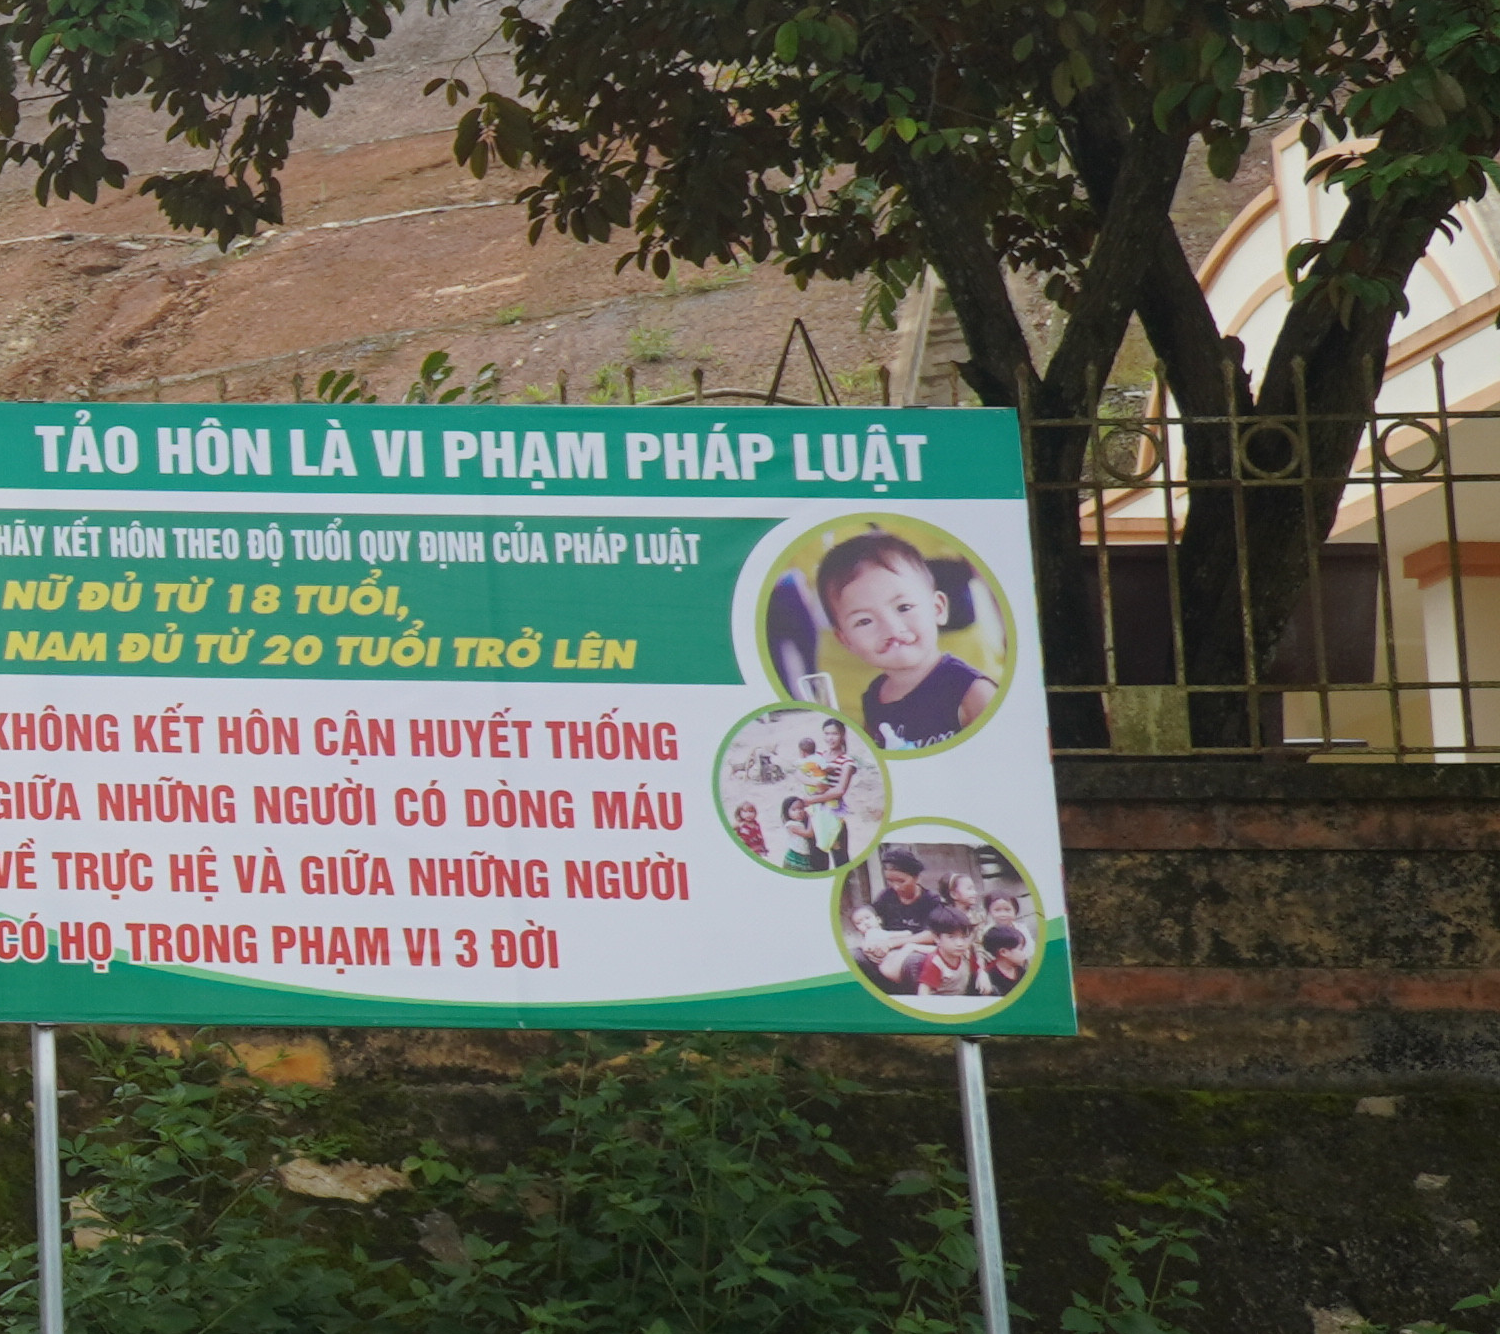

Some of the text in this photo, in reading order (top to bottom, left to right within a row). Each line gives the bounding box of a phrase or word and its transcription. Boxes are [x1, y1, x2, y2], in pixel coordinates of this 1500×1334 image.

[35, 409, 928, 493] TẢO HÔN LÀ VI PHẠM PHÁP LUẬT
[53, 516, 103, 559] KẾT
[110, 520, 165, 560] HÔN
[172, 527, 239, 560] THEO
[247, 522, 284, 567] ĐỘ
[290, 517, 351, 563] TUỔI
[359, 530, 410, 565] QUY
[419, 531, 485, 569] ĐỊNH
[492, 522, 548, 565] CỦA
[555, 526, 628, 565] PHÁP
[634, 527, 700, 572] LUẬT
[2, 569, 409, 621] NỮ ĐỦ TỪ 18 TUỔI,
[3, 620, 638, 670] NAM ĐỦ TỪ 20 TUỔI TRỞ LÊN
[133, 702, 204, 754] KẾT
[218, 708, 301, 755] HÔN
[313, 709, 396, 766] CẬN
[409, 707, 533, 759] HUYẾT
[545, 707, 679, 762] THỐNG
[97, 776, 237, 824] NHỮNG
[253, 777, 377, 827] NGƯỜI
[394, 779, 447, 828] CÓ
[464, 779, 575, 830] DÒNG
[592, 782, 684, 832] MÁU
[51, 849, 154, 900] TRỰC
[169, 846, 219, 902] HỆ
[233, 847, 287, 894] VÀ
[300, 848, 395, 897] GIỮA
[408, 850, 550, 899] NHỮNG
[564, 851, 690, 902] NGƯỜI
[60, 922, 113, 972] HỌ
[125, 923, 259, 965] TRONG
[272, 925, 391, 975] PHẠM
[402, 927, 441, 967] VI
[454, 929, 479, 968] 3
[490, 919, 560, 969] ĐỜI
